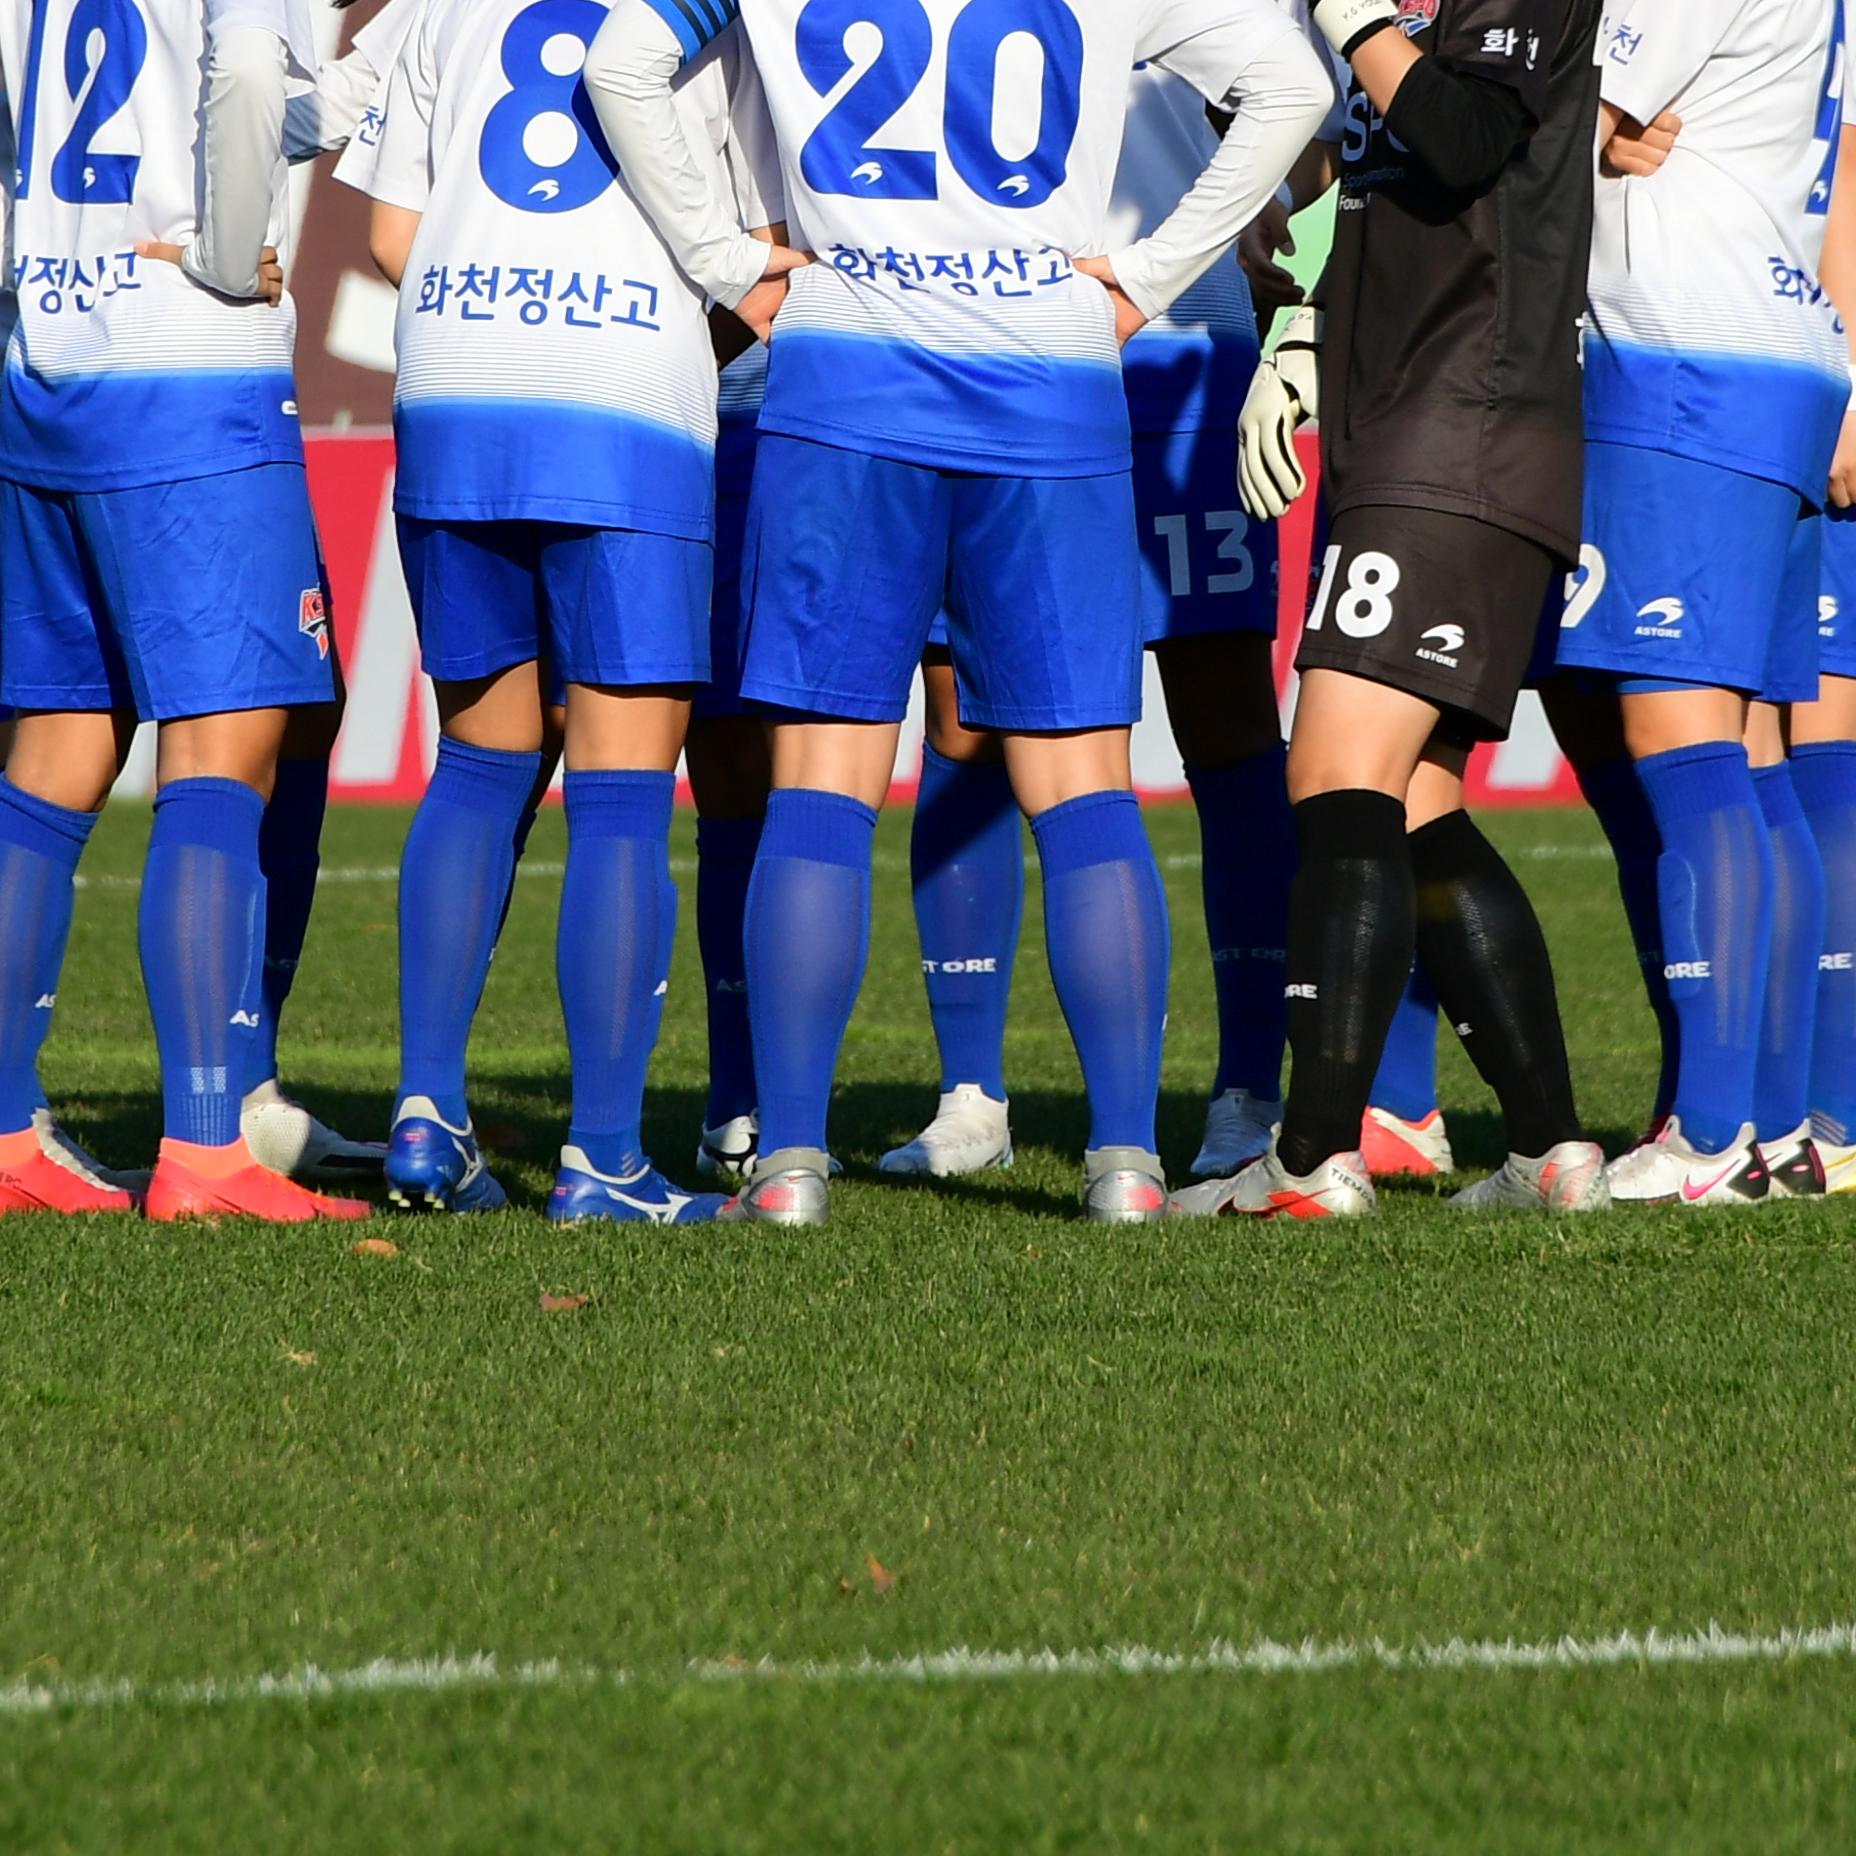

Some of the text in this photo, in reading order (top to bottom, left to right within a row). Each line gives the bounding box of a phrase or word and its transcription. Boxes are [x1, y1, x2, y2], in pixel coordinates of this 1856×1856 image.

[415, 262, 661, 332] 화천정산고
[1154, 510, 1254, 596] 13
[1306, 544, 1401, 638] 18
[1415, 647, 1459, 669] ASTORE
[1634, 625, 1683, 639] ASTORE
